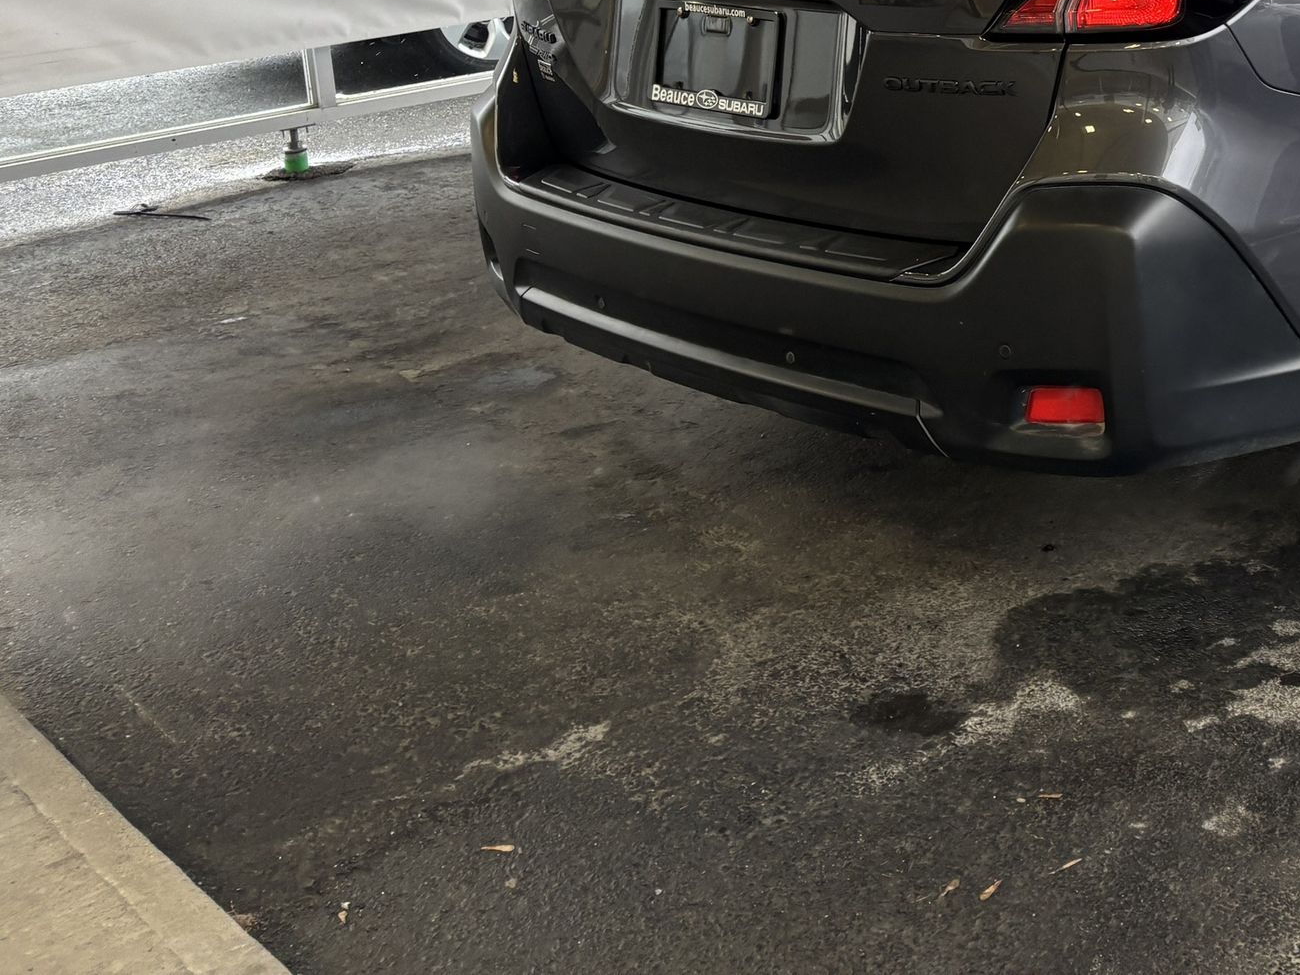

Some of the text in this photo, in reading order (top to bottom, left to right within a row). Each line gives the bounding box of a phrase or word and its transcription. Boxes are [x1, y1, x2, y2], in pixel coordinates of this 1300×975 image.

[684, 1, 746, 18] beaucesubaru.com
[882, 76, 1018, 97] OUTBACK
[651, 84, 764, 116] Beauce SUBARU
